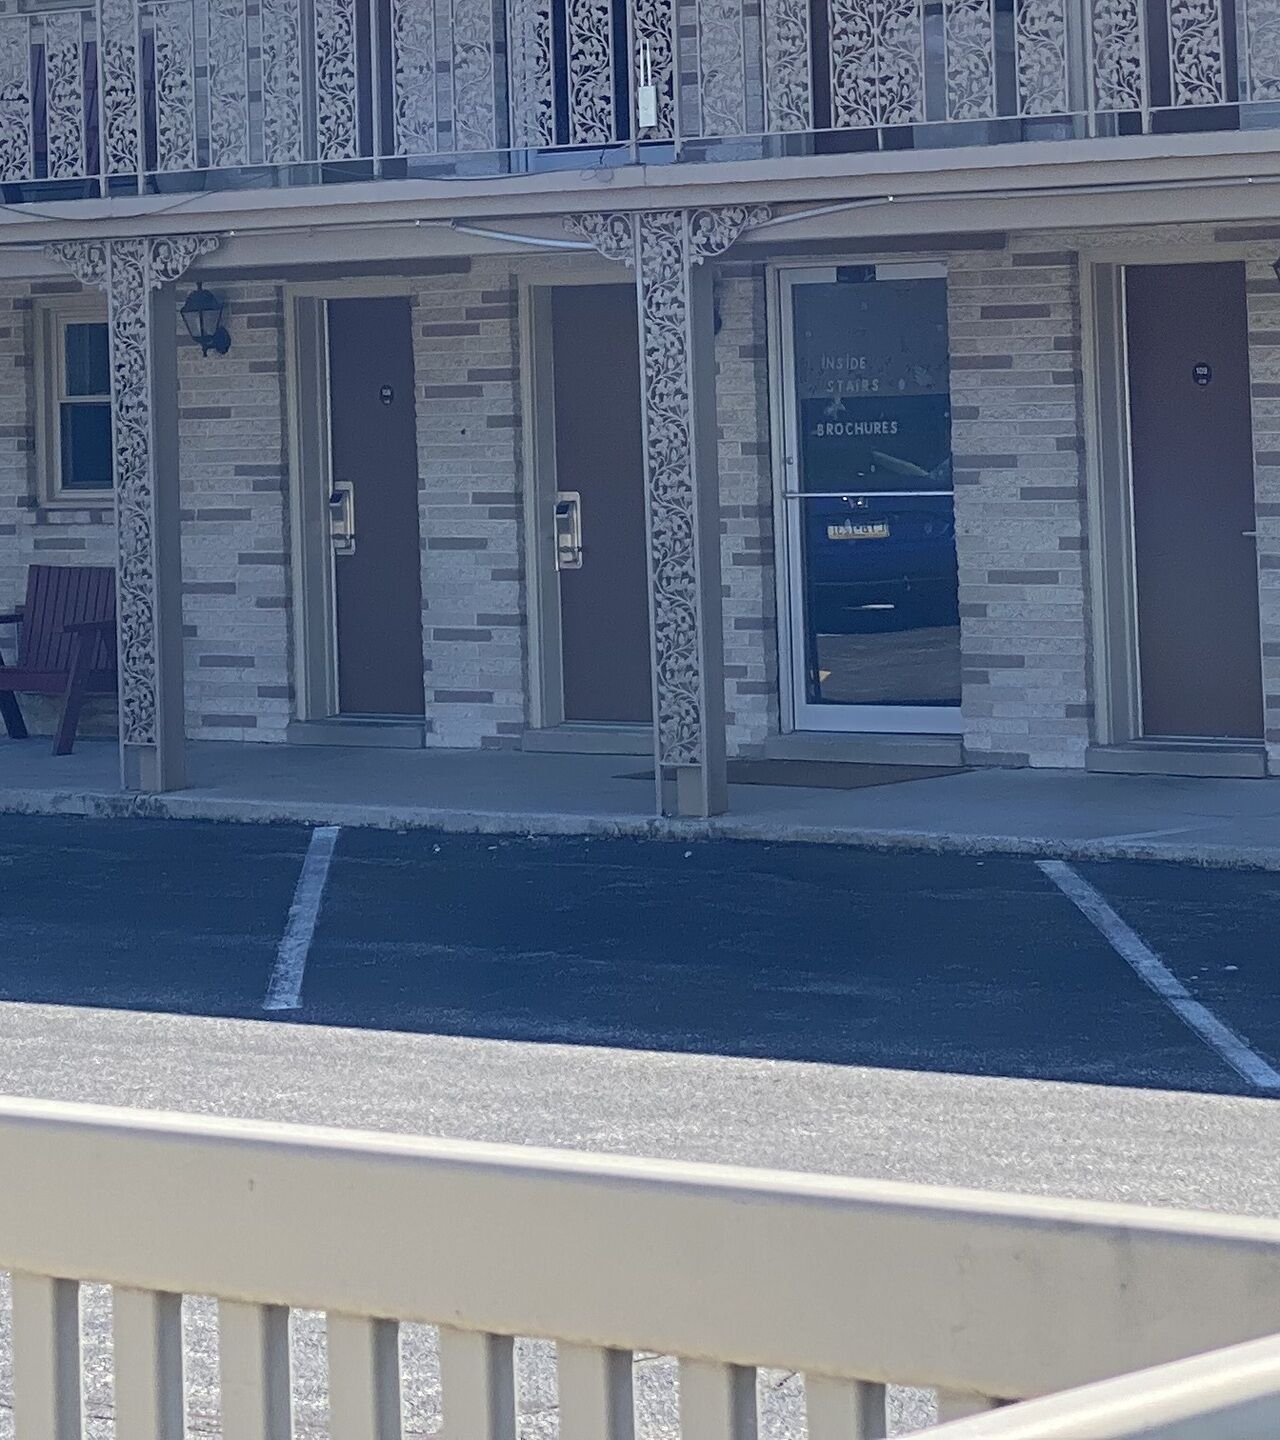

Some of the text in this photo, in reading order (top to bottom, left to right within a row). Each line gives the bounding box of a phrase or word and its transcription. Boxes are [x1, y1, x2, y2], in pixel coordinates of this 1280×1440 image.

[822, 355, 866, 370] INSIDE
[827, 379, 879, 392] STAIRS
[817, 421, 898, 436] BROCHURES
